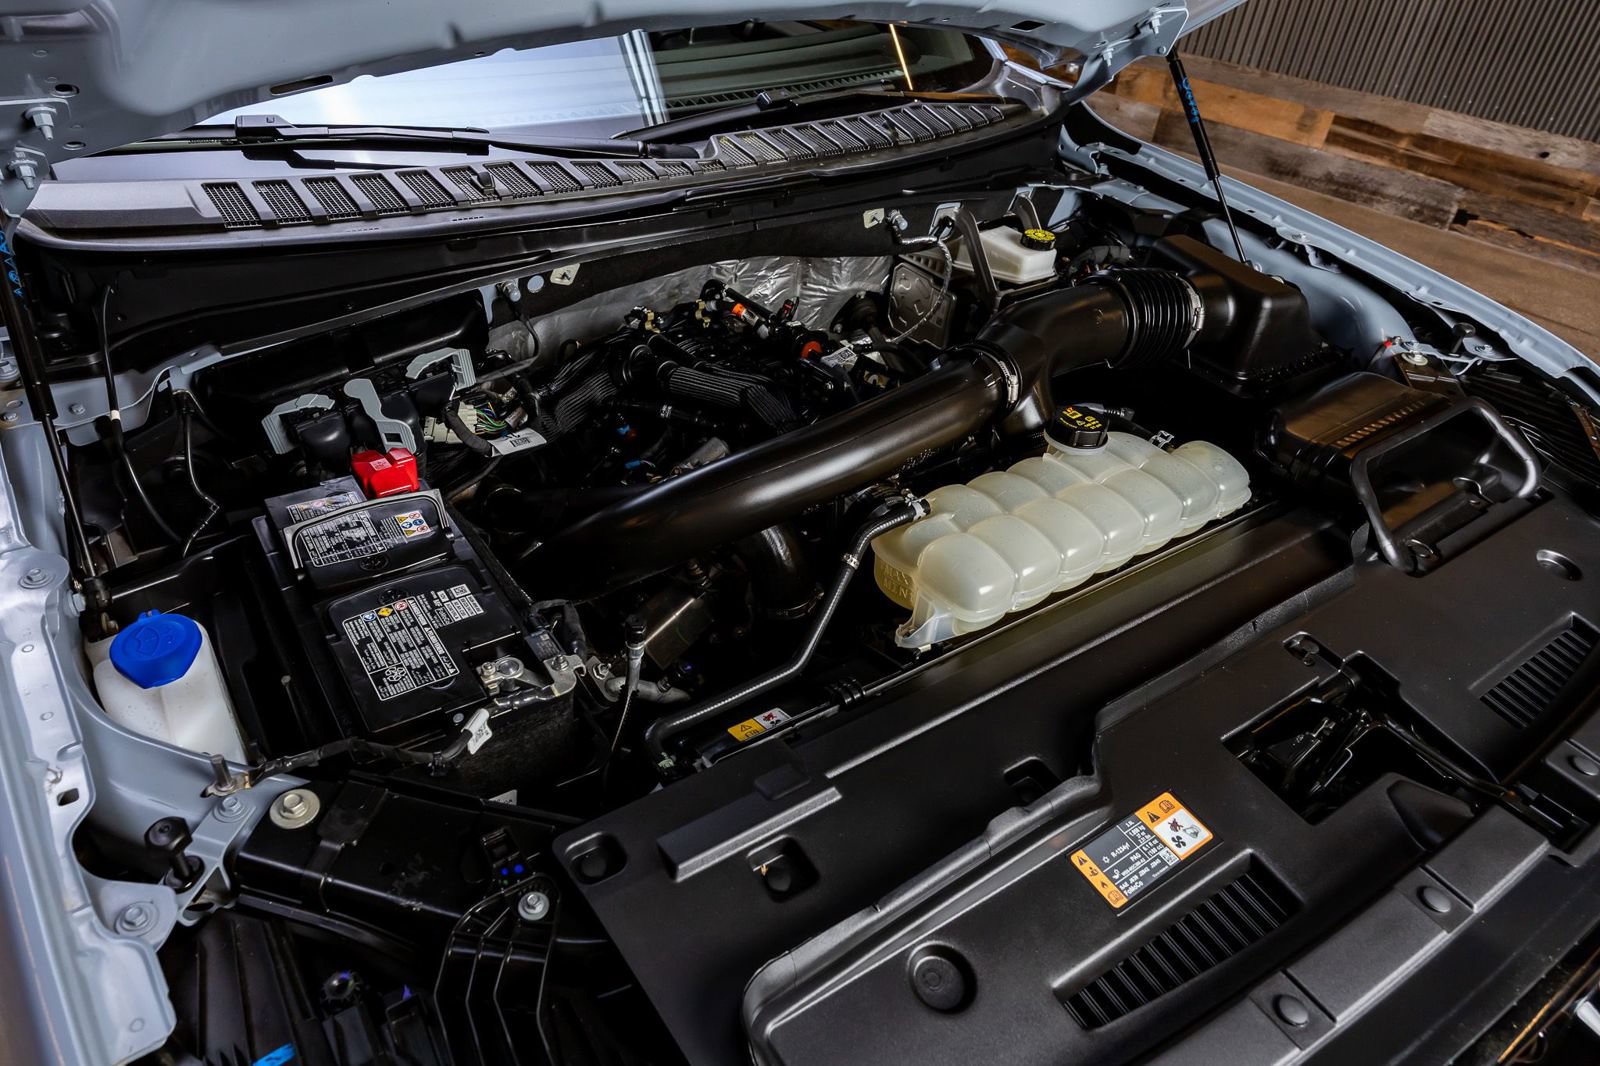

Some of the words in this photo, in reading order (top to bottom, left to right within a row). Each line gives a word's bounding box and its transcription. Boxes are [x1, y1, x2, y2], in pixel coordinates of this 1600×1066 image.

[1110, 842, 1130, 858] R-1234yf
[1130, 852, 1142, 862] PAG
[1124, 881, 1144, 896] FoMoCo
